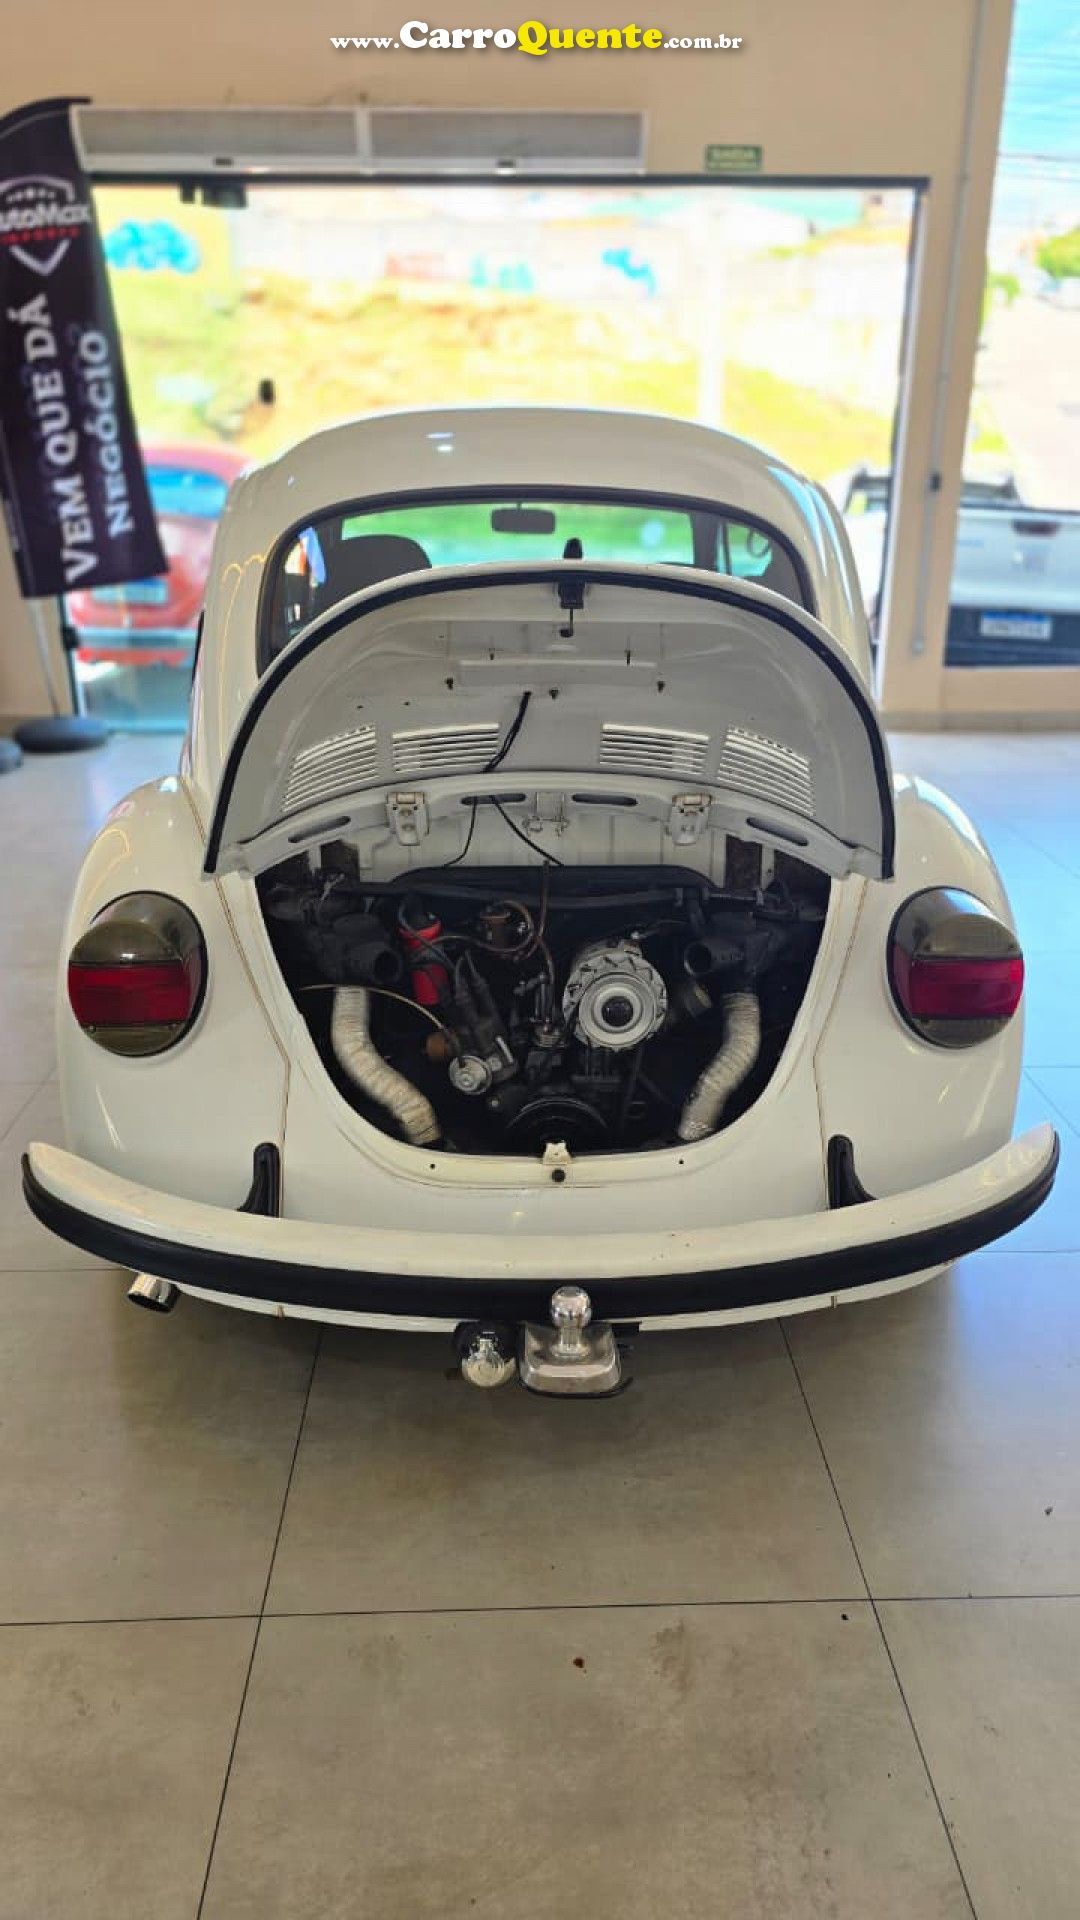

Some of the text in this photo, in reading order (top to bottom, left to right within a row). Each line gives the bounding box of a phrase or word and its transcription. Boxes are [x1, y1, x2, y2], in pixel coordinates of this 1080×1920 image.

[7, 294, 57, 363] DÁ
[32, 369, 79, 466] QUE
[79, 332, 135, 538] NEGÓCIO
[53, 474, 99, 584] VEM
